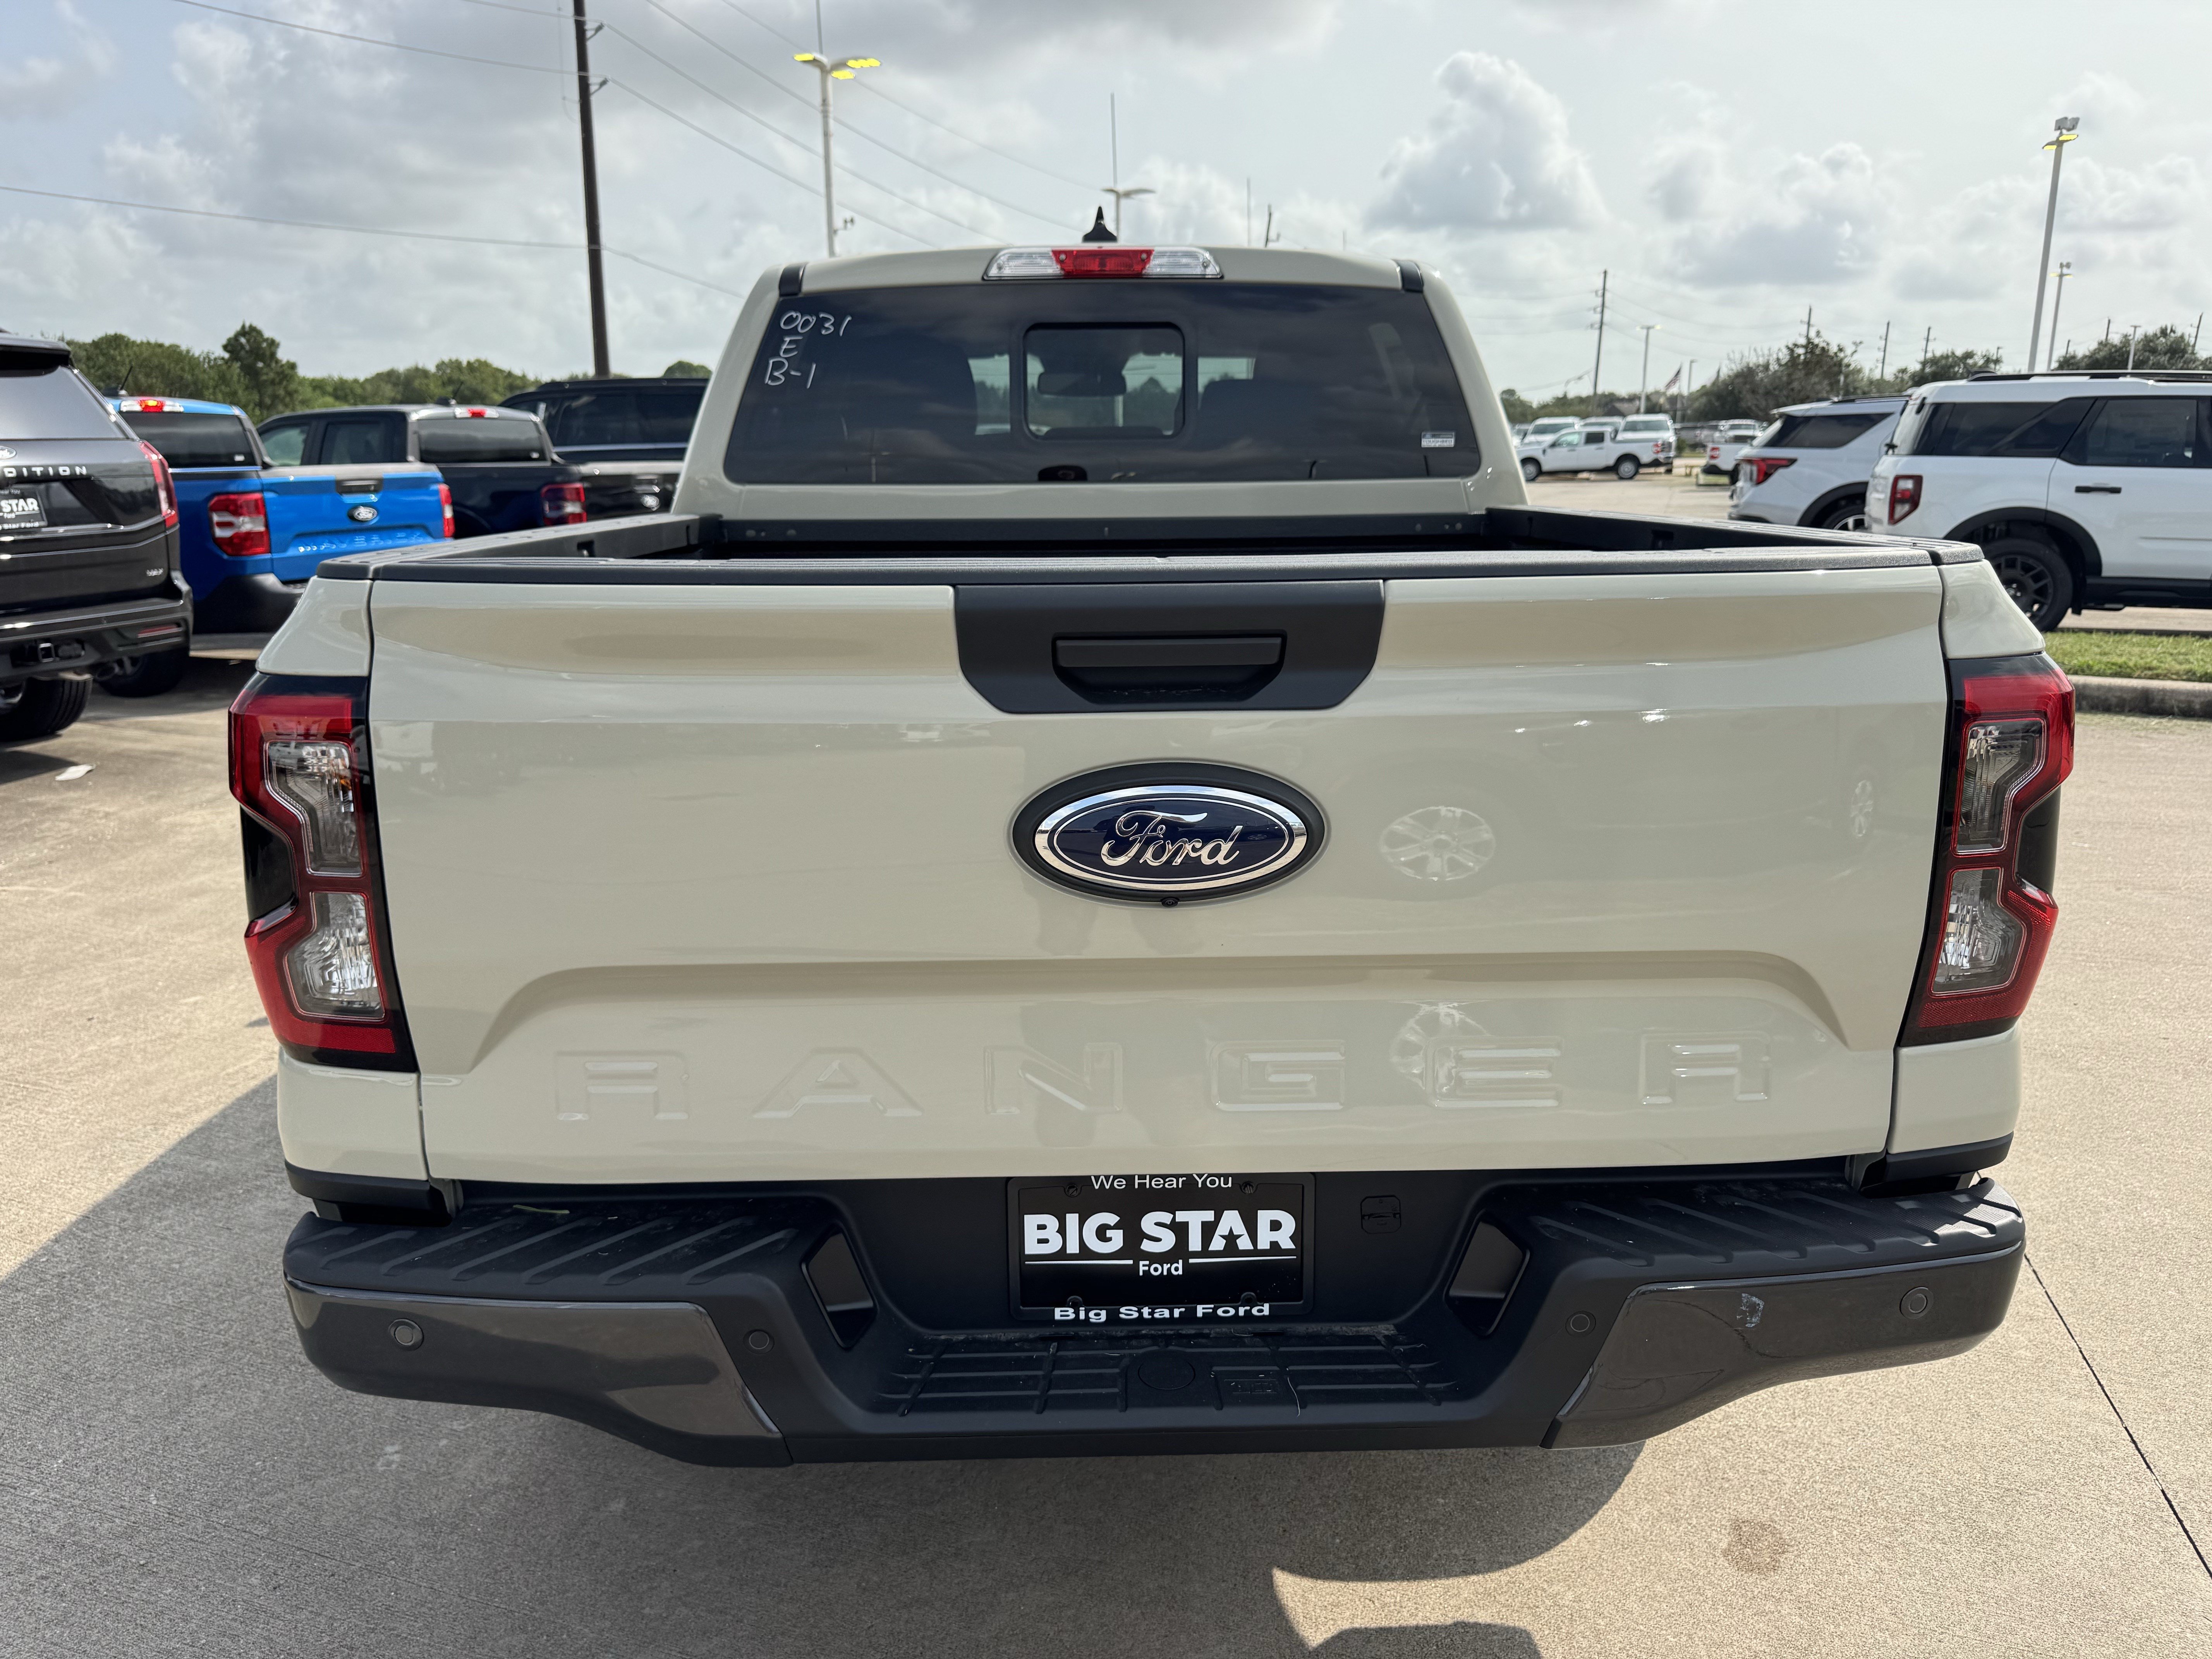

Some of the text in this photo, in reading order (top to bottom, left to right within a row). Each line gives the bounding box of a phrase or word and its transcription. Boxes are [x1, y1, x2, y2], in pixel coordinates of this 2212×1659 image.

[780, 311, 852, 337] 0031
[780, 336, 803, 357] E
[764, 356, 816, 388] B-1
[0, 498, 39, 512] STAR
[1101, 810, 1243, 866] Ford
[554, 1029, 1772, 1121] RANGER
[1091, 1173, 1232, 1189] We Hear You
[1024, 1210, 1296, 1255] BIG STAR
[1139, 1260, 1183, 1276] Ford
[1054, 1303, 1269, 1323] Big Star Ford
